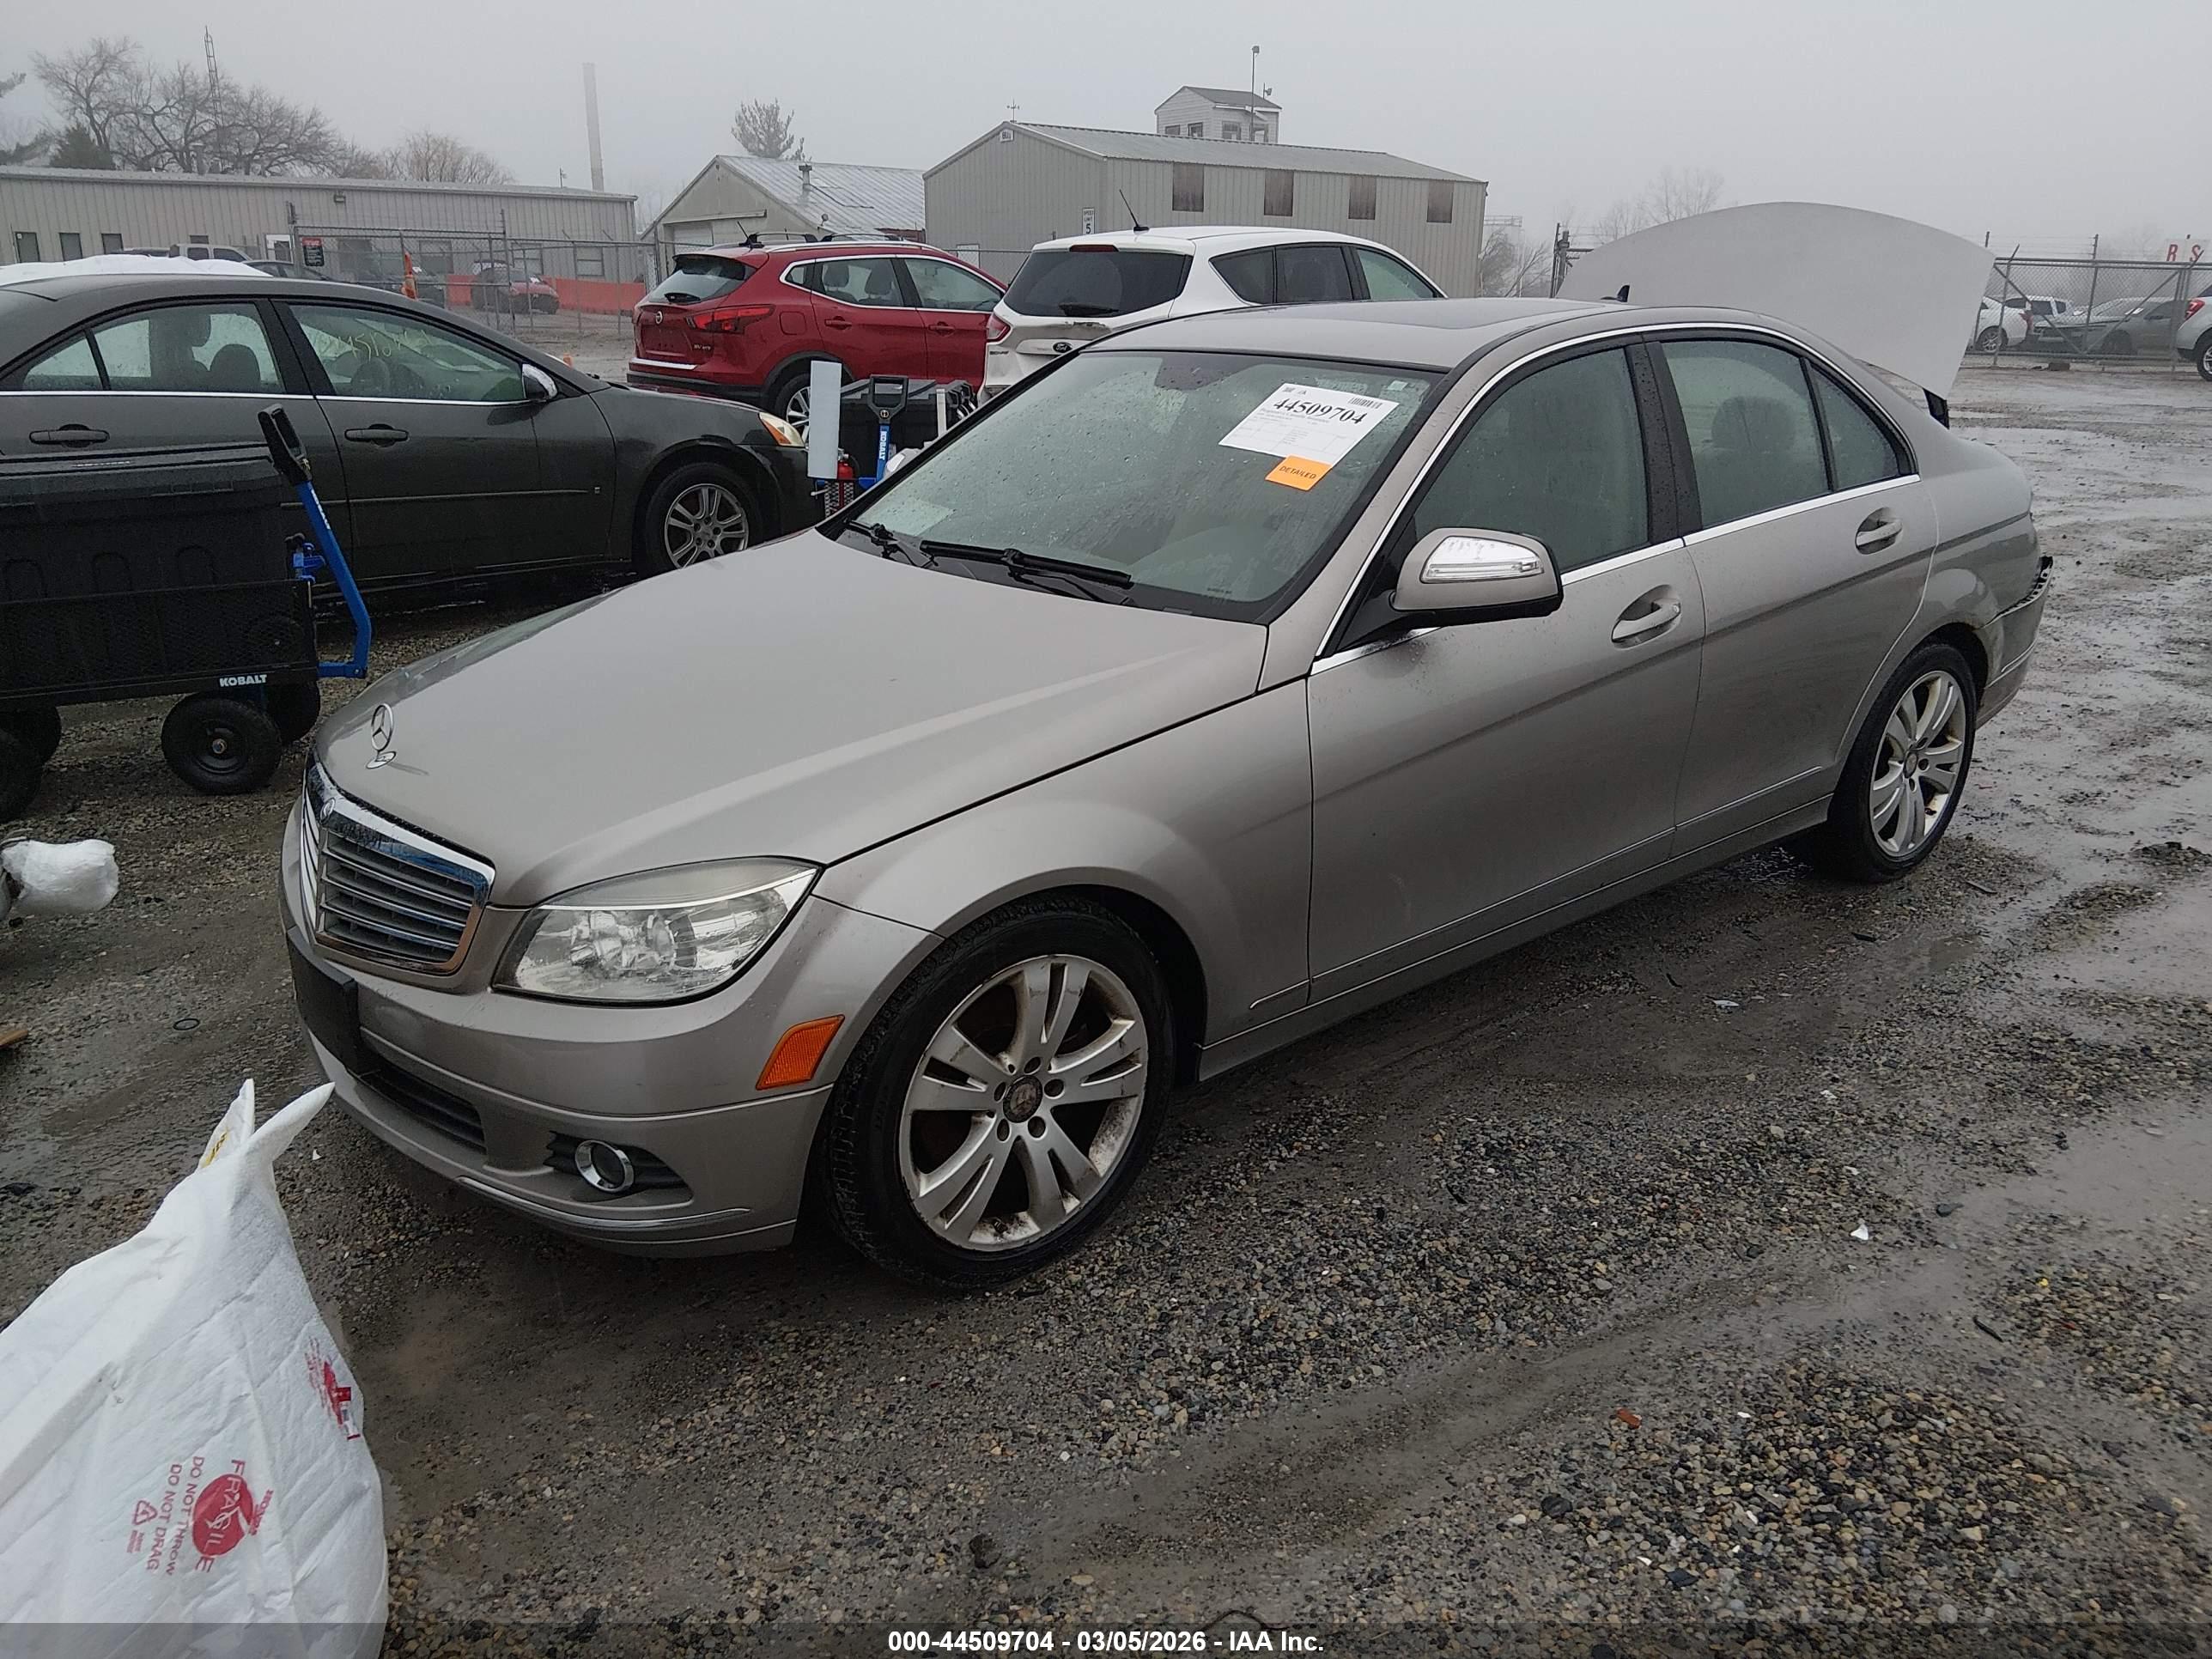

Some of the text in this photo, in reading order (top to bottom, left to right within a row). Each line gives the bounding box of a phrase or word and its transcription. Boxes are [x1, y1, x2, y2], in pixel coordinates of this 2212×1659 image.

[1085, 223, 1091, 234] 5
[2166, 244, 2179, 262] R
[1273, 398, 1368, 424] 44509704
[1279, 465, 1317, 480] DETAILED
[219, 674, 267, 687] KOBALT
[146, 1463, 182, 1572] DO NOT DRAG
[166, 1455, 205, 1576] DO NOT THROW
[194, 1459, 246, 1573] FRAGILE
